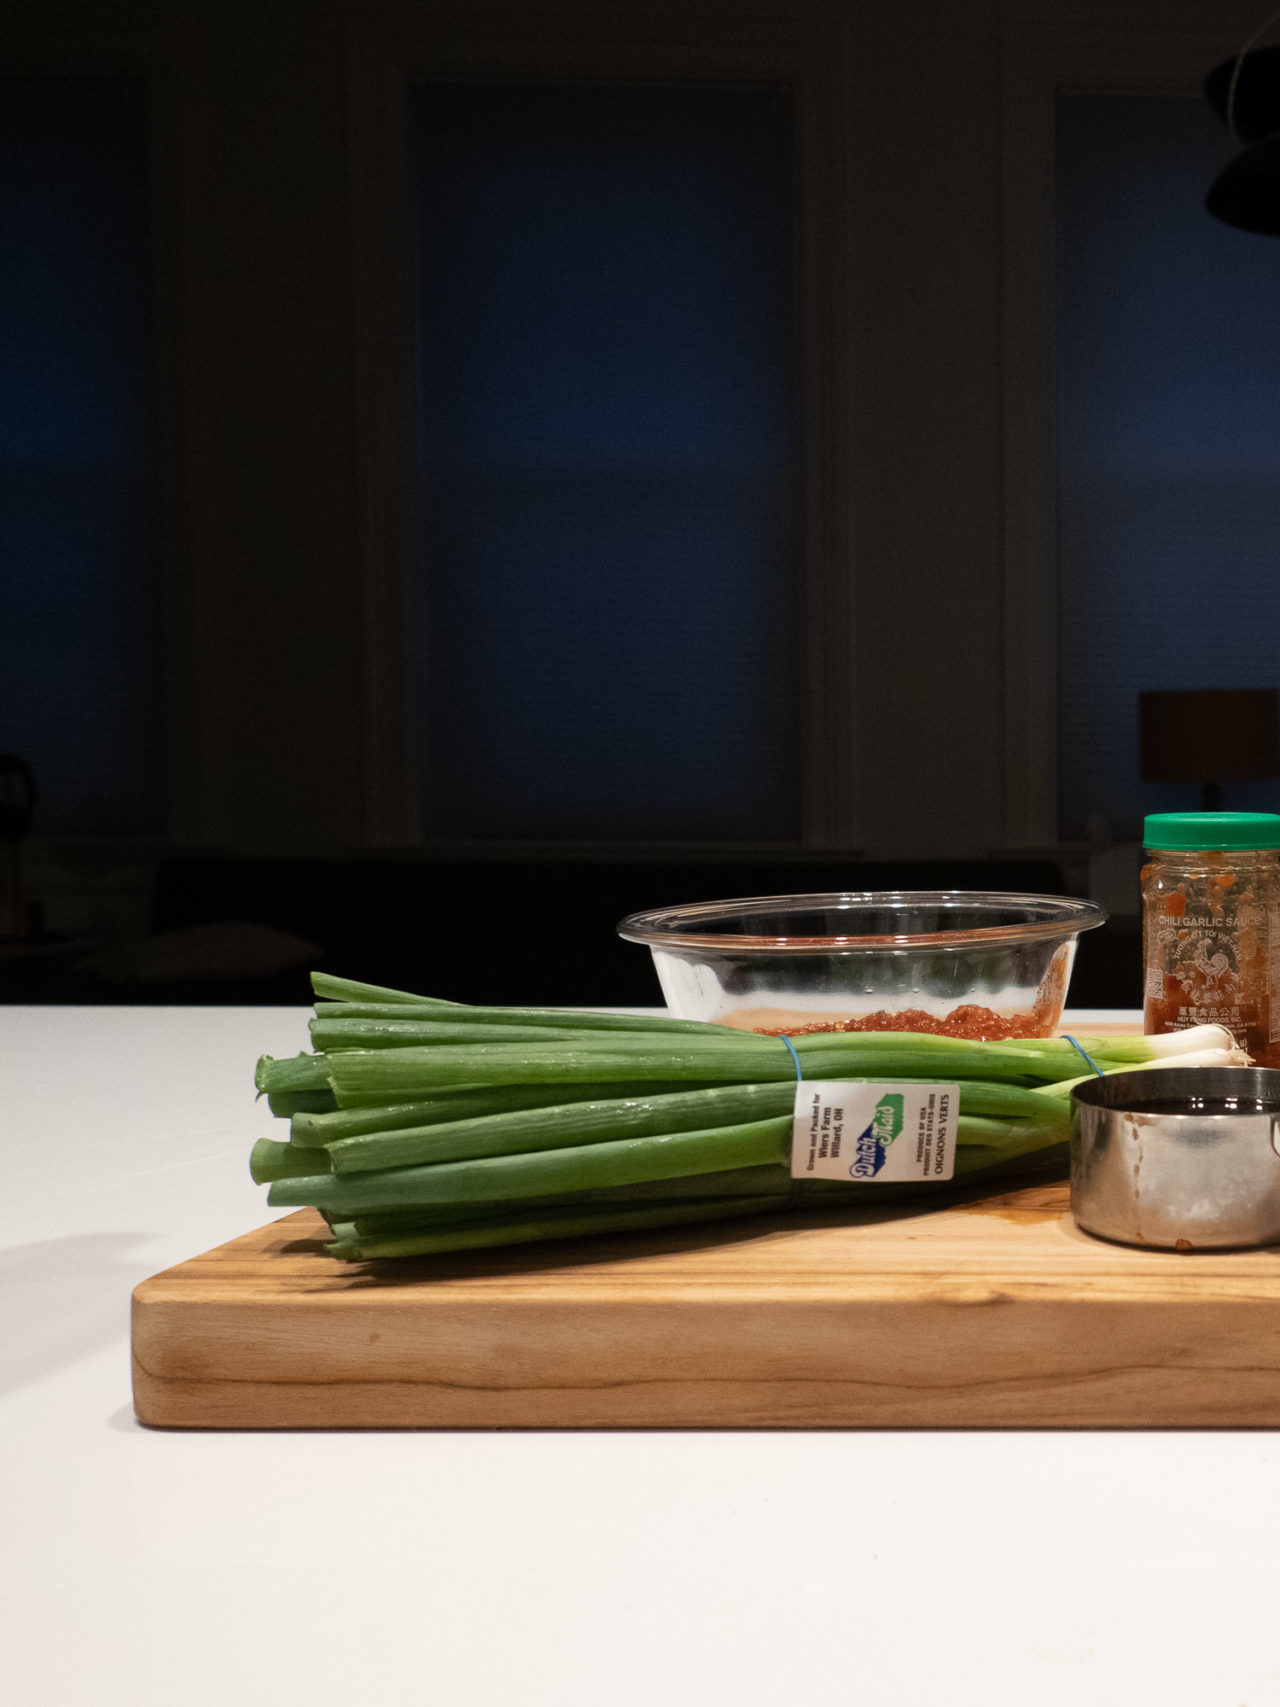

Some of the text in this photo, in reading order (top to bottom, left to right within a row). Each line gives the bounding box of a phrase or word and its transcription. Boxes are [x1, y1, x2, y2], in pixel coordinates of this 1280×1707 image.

[1159, 915, 1262, 927] CHILI GARLIC SAUCE
[806, 1093, 821, 1171] Grown and Packed for
[820, 1106, 832, 1131] Farm
[830, 1108, 844, 1159] Willard, OH
[849, 1105, 894, 1179] Dutch Maid
[916, 1106, 927, 1163] PRODUCE OF USA
[924, 1133, 933, 1147] DES
[934, 1093, 950, 1175] OIGNONS VERTS
[923, 1147, 932, 1176] PRODUIT
